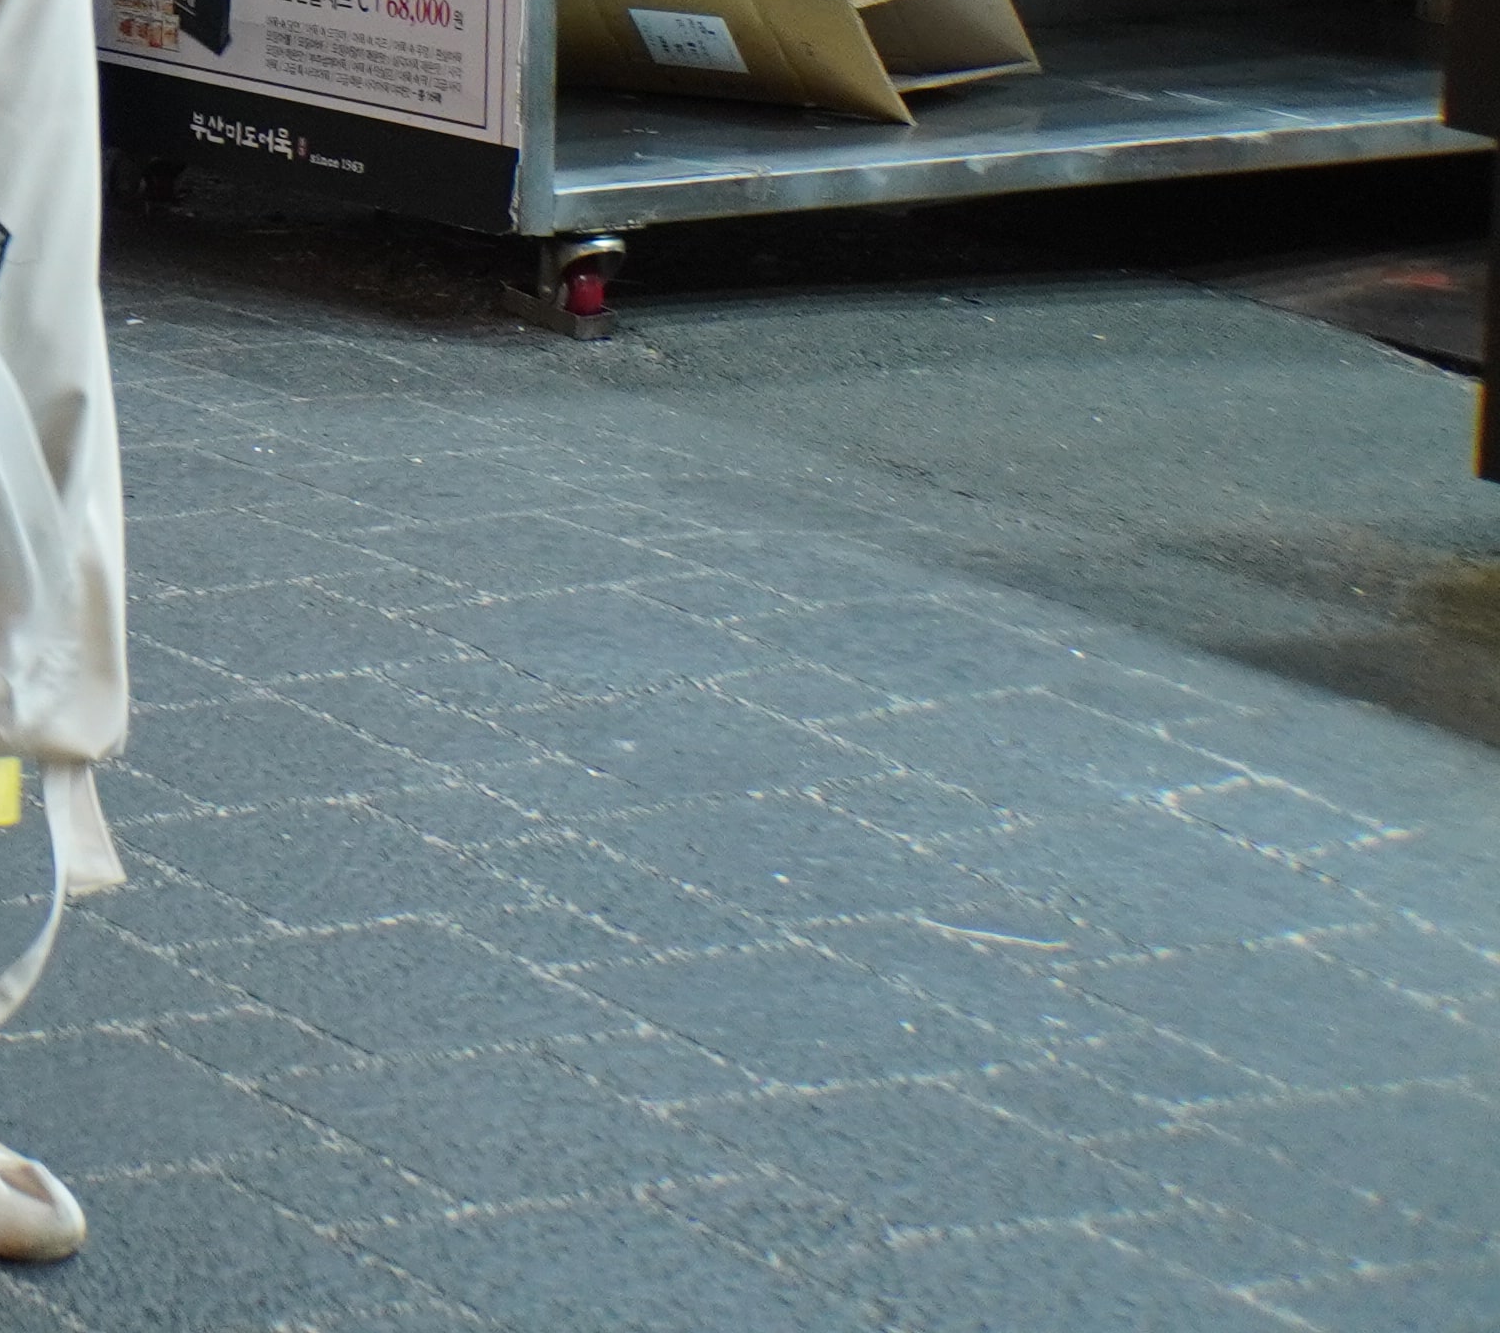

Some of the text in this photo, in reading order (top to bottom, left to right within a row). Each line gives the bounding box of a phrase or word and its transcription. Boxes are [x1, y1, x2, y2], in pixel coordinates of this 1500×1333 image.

[453, 9, 465, 32] 원
[189, 110, 294, 161] 부산미도어묵
[309, 153, 366, 175] since 1963
